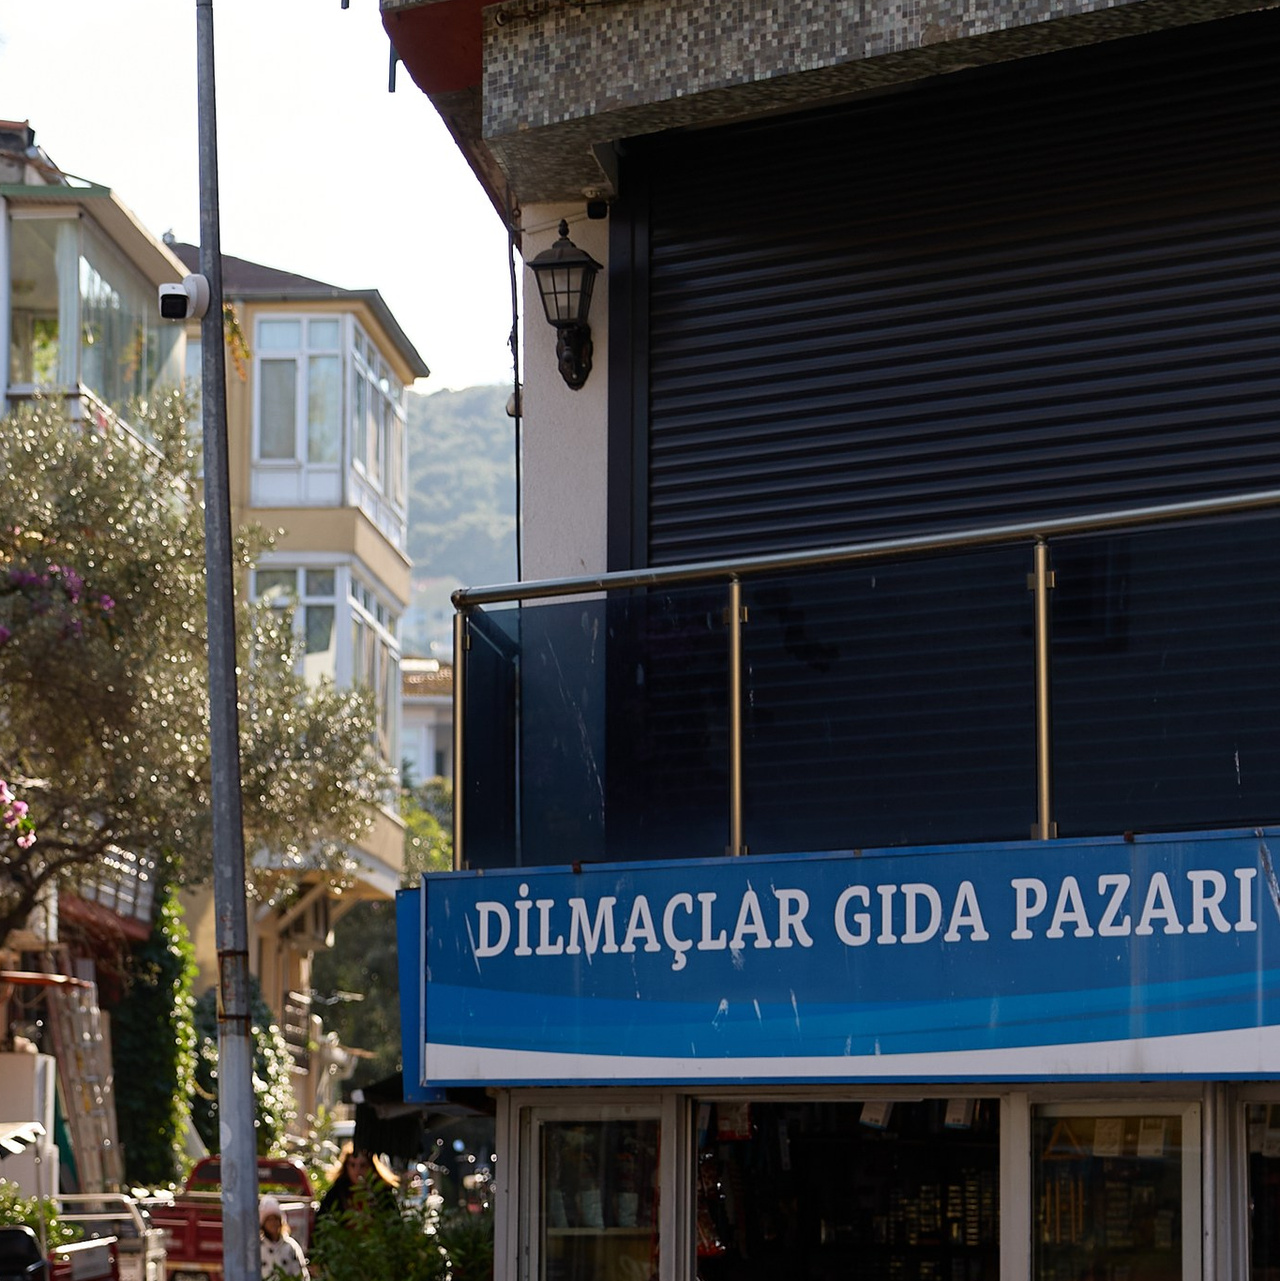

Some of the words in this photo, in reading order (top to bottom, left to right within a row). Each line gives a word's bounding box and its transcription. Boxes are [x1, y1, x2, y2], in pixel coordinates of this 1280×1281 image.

[474, 881, 813, 971] DİLMAÇLAR
[834, 879, 990, 947] GIDA
[1011, 866, 1258, 941] PAZARI
